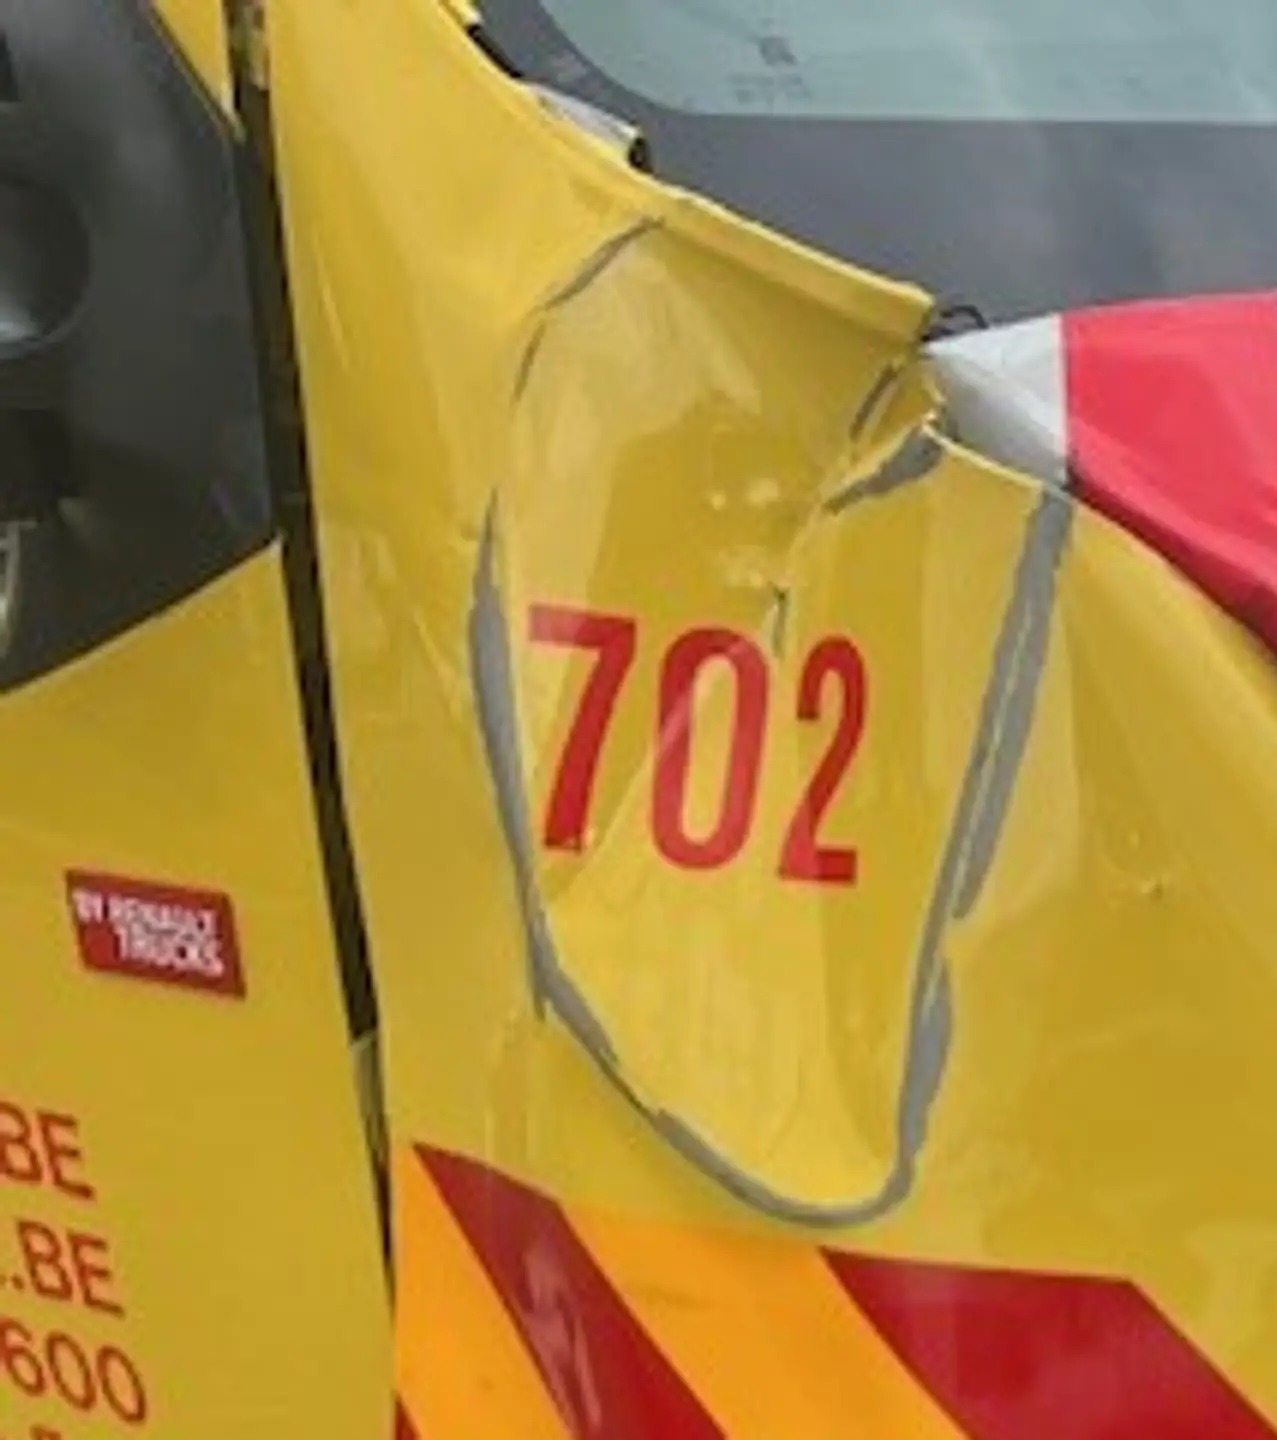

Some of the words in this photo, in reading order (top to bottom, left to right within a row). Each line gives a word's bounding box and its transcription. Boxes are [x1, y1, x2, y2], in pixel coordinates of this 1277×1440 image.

[528, 604, 867, 884] 702
[115, 924, 224, 978] TRUCKS
[0, 1220, 124, 1317] .BE
[0, 1318, 147, 1424] 600
